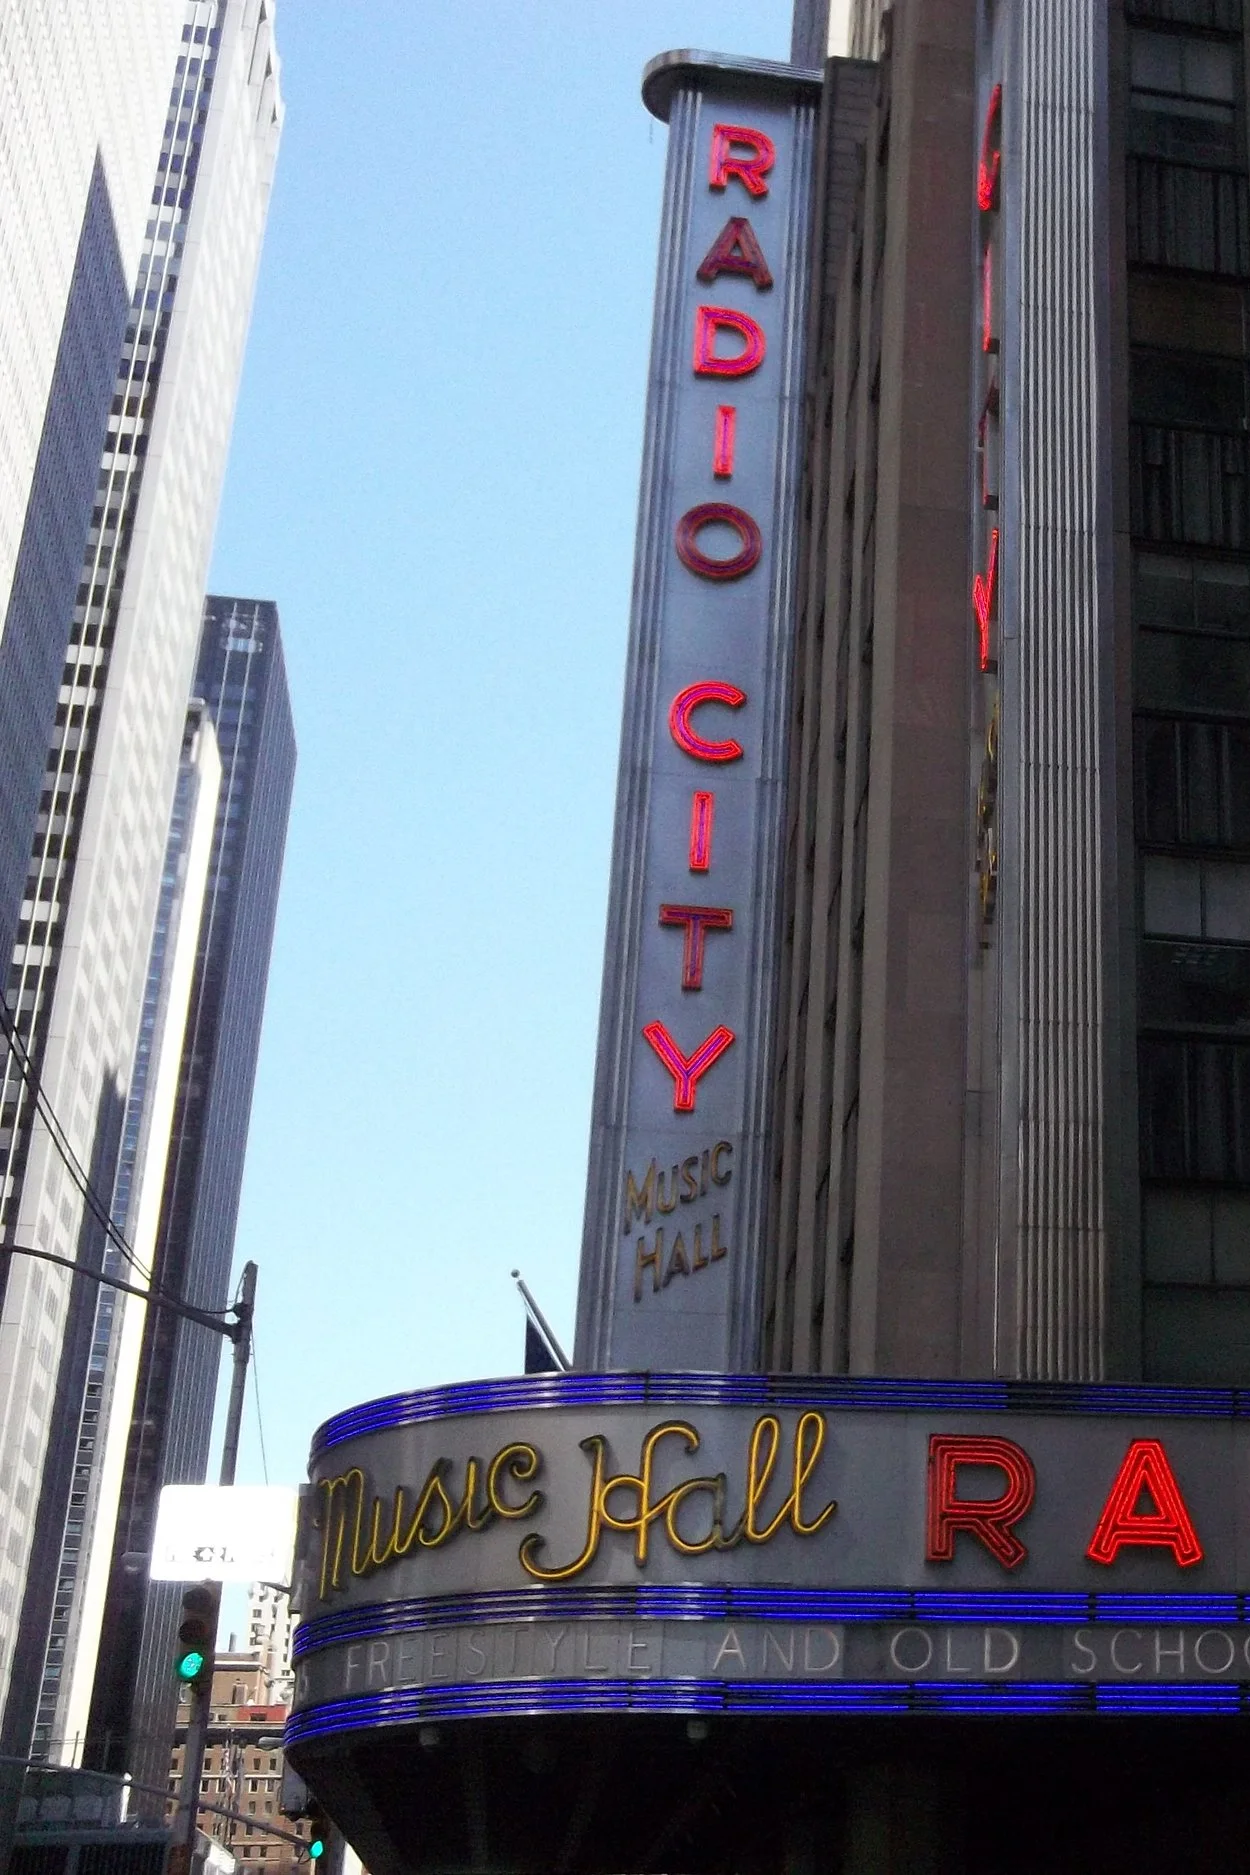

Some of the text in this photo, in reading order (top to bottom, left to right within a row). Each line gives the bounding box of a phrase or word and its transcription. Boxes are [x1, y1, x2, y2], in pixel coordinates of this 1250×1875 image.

[674, 122, 776, 580] RADIO
[641, 680, 747, 1113] CITY
[624, 1140, 733, 1236] MUSIC
[633, 1212, 727, 1302] HALL
[319, 1409, 838, 1598] Music Hall
[345, 1620, 654, 1690] FREESTYLE
[711, 1626, 843, 1673] AND
[890, 1627, 1020, 1673] OLD
